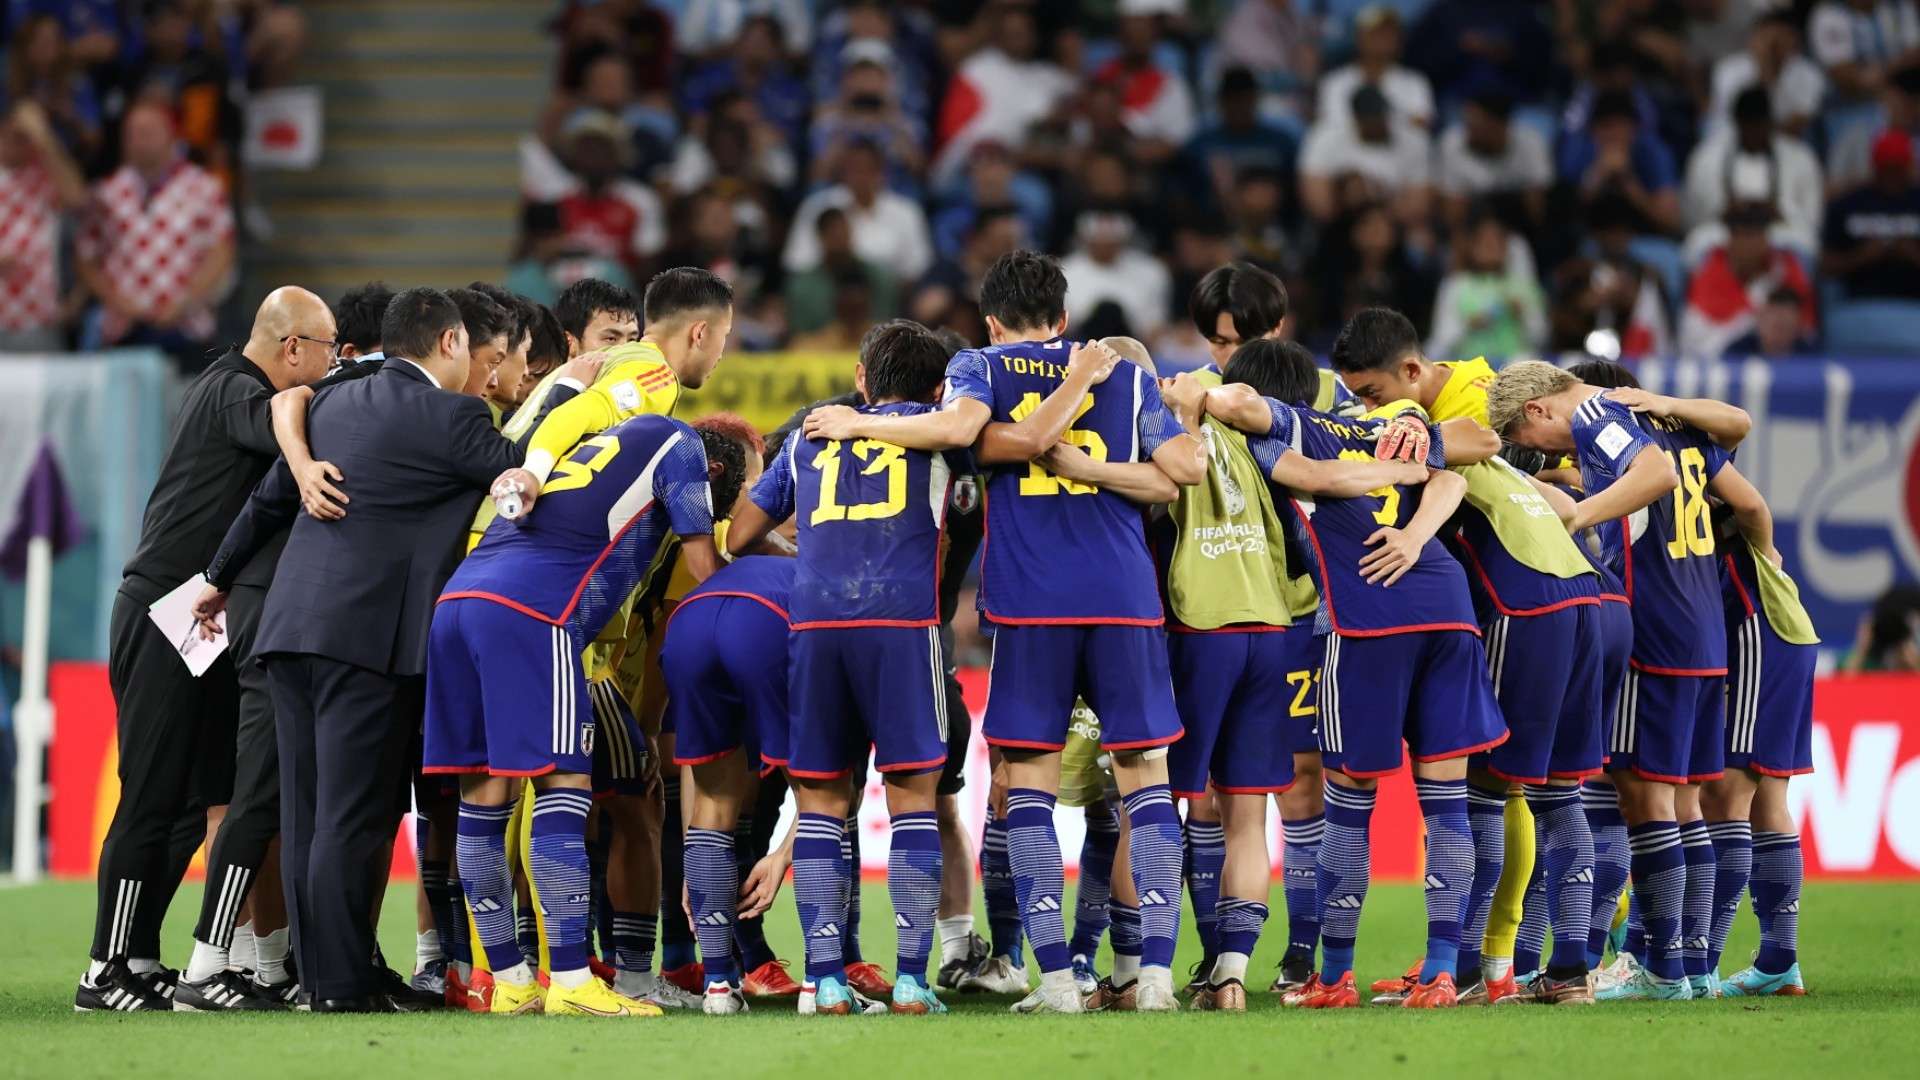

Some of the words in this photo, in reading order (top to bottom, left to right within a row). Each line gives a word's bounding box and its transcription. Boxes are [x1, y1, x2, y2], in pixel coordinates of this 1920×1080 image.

[1001, 354, 1071, 380] TOMIY
[811, 438, 909, 528] 13
[1664, 446, 1716, 560] 18
[1194, 525, 1224, 541] FIFA
